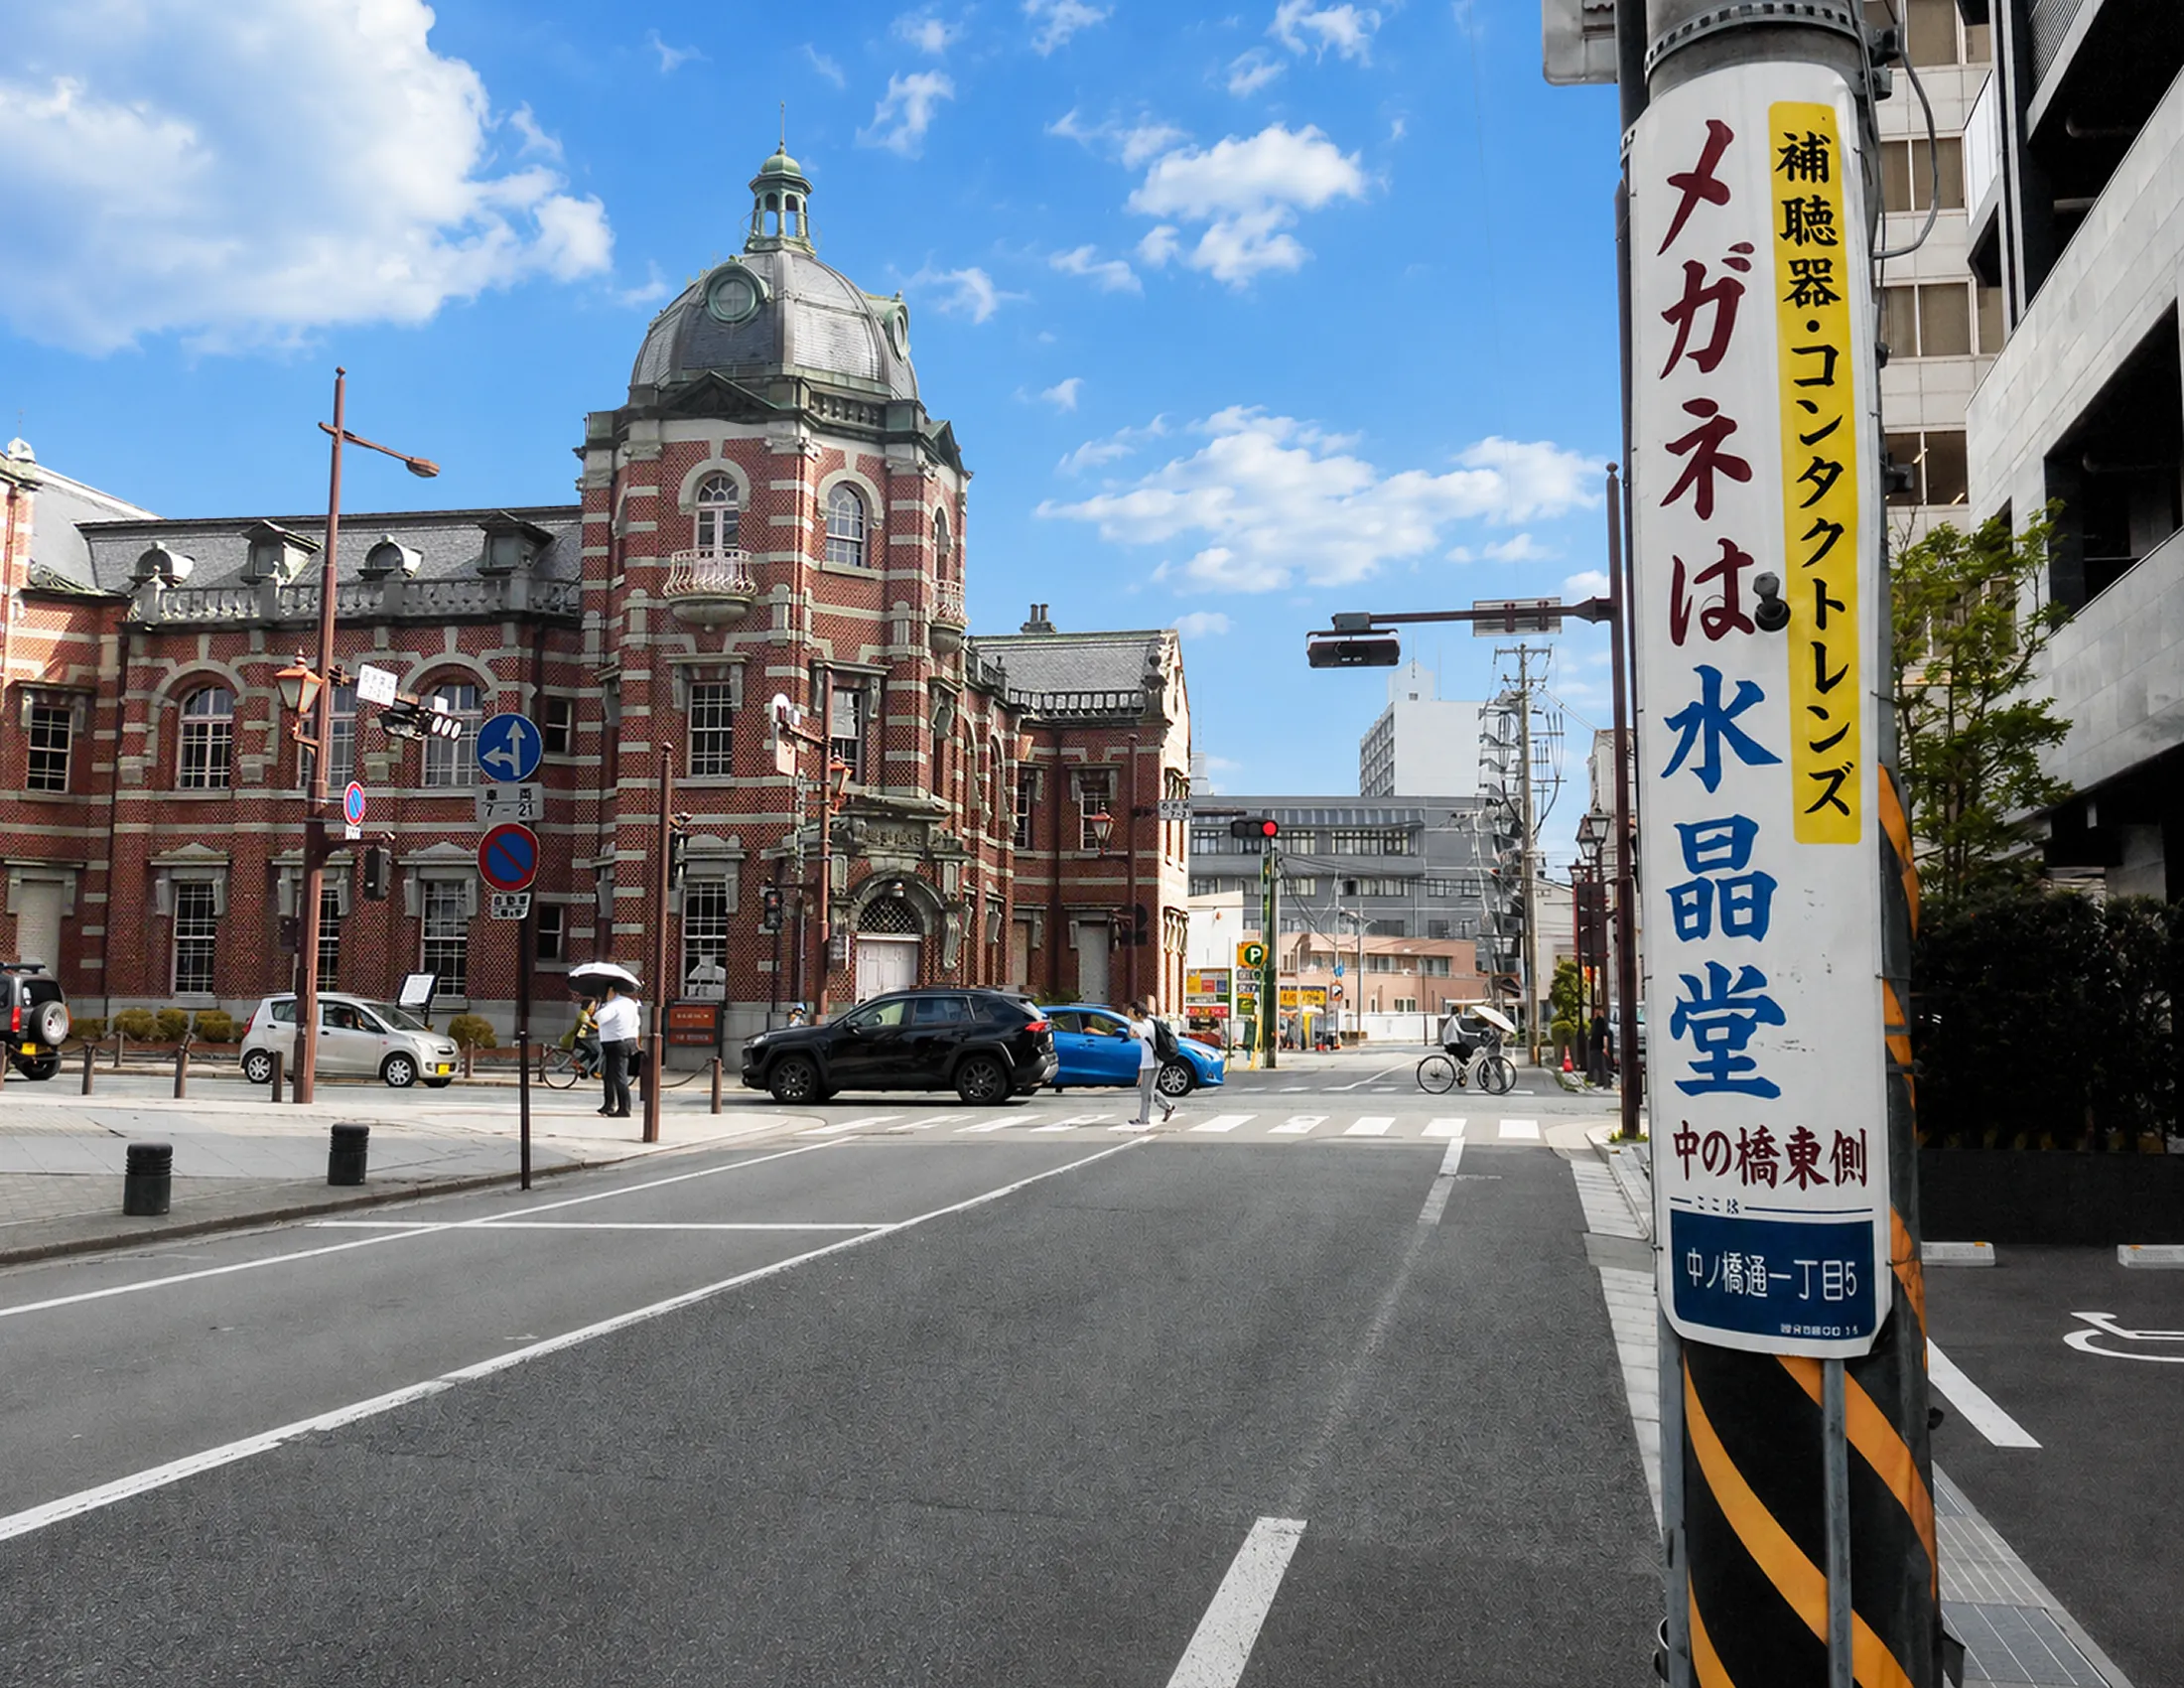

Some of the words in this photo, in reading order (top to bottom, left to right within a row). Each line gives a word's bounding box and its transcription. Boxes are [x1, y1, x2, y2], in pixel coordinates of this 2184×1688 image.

[1775, 131, 1854, 817] 補聴器・コンタクトレンズ
[1250, 947, 1262, 962] P
[1673, 1119, 1867, 1192] 中の橋東側
[1687, 1247, 1857, 1301] 中ノ橋通一丁目5
